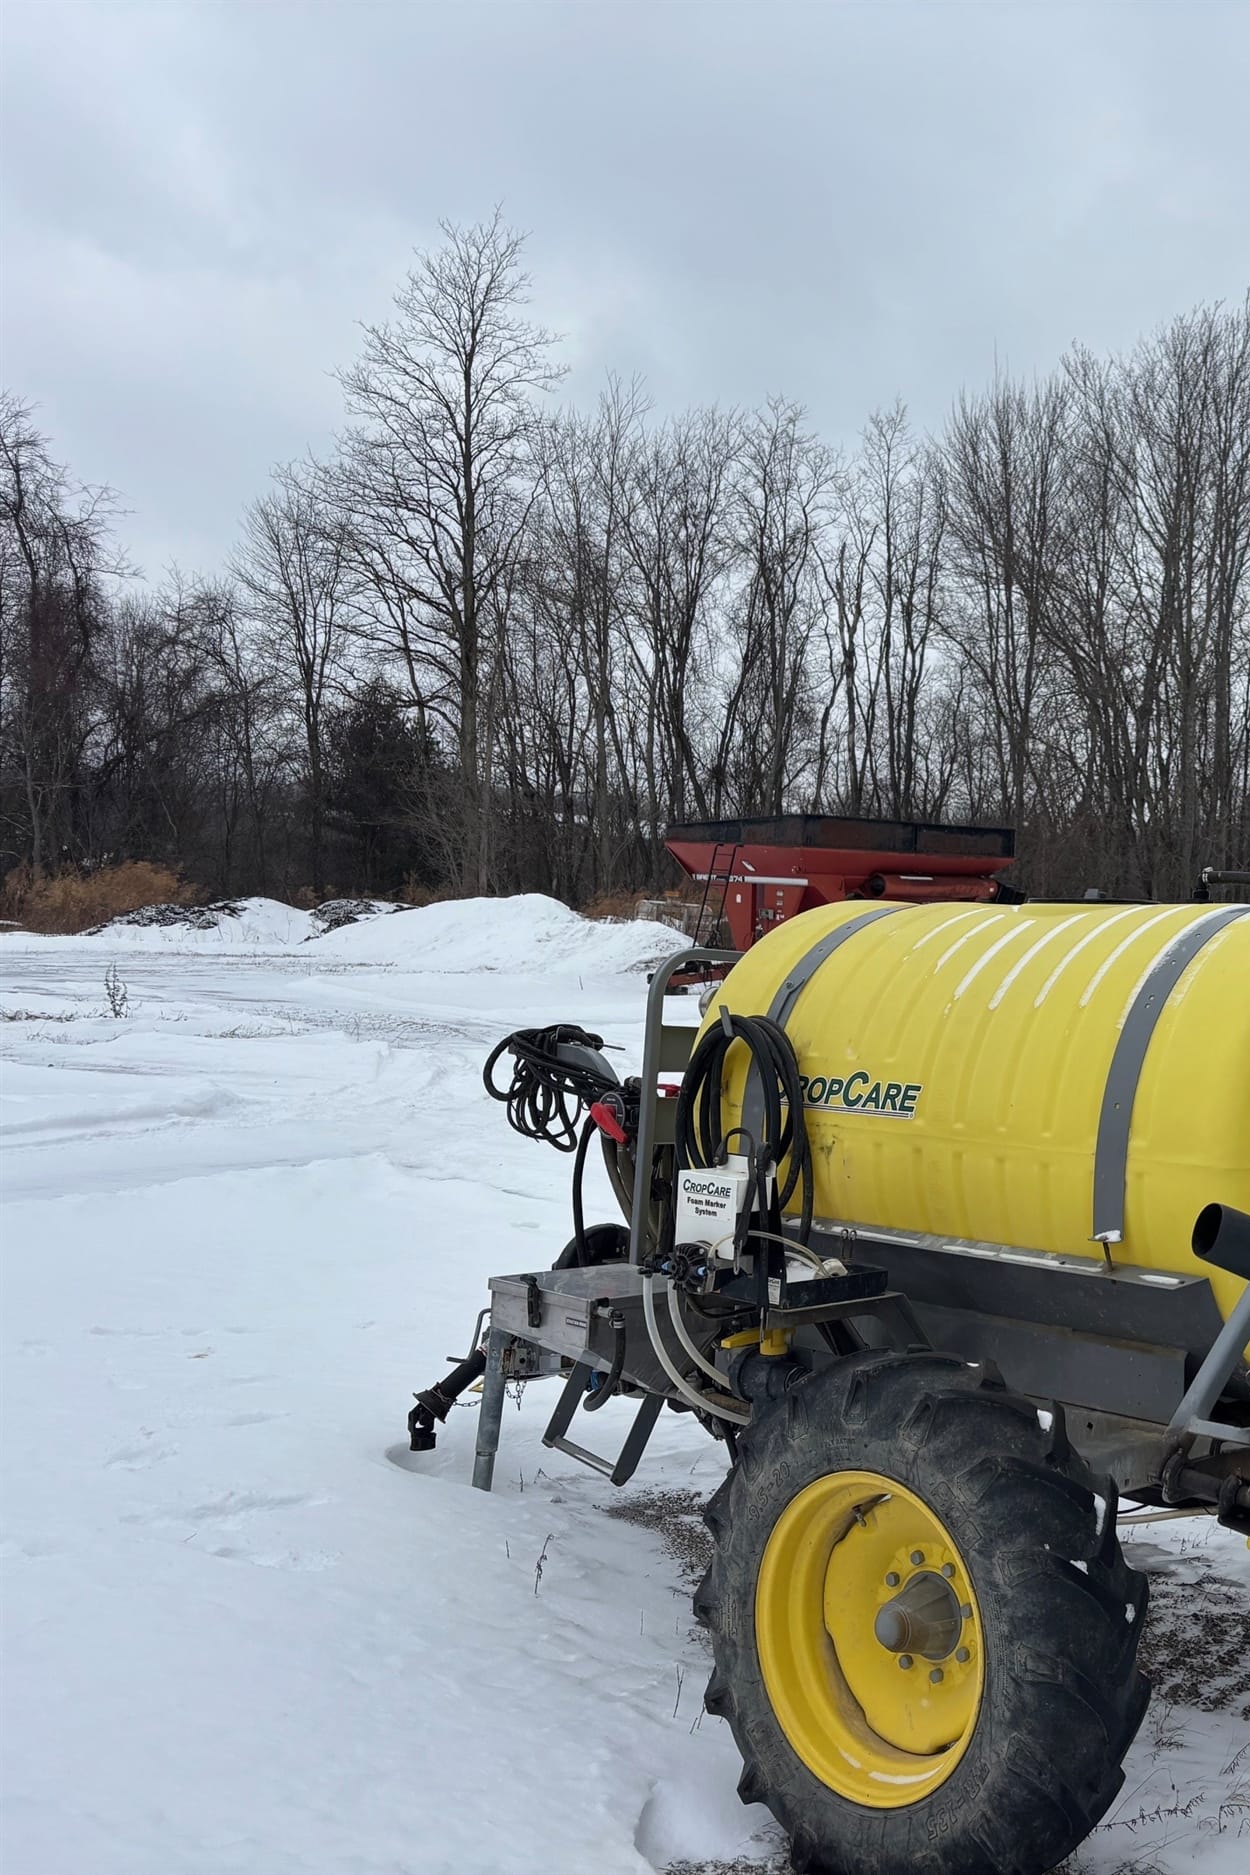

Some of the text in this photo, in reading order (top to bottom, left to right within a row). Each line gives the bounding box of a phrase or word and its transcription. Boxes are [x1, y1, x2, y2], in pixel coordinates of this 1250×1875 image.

[687, 1196, 726, 1209] Foam Marker
[695, 1206, 717, 1217] System
